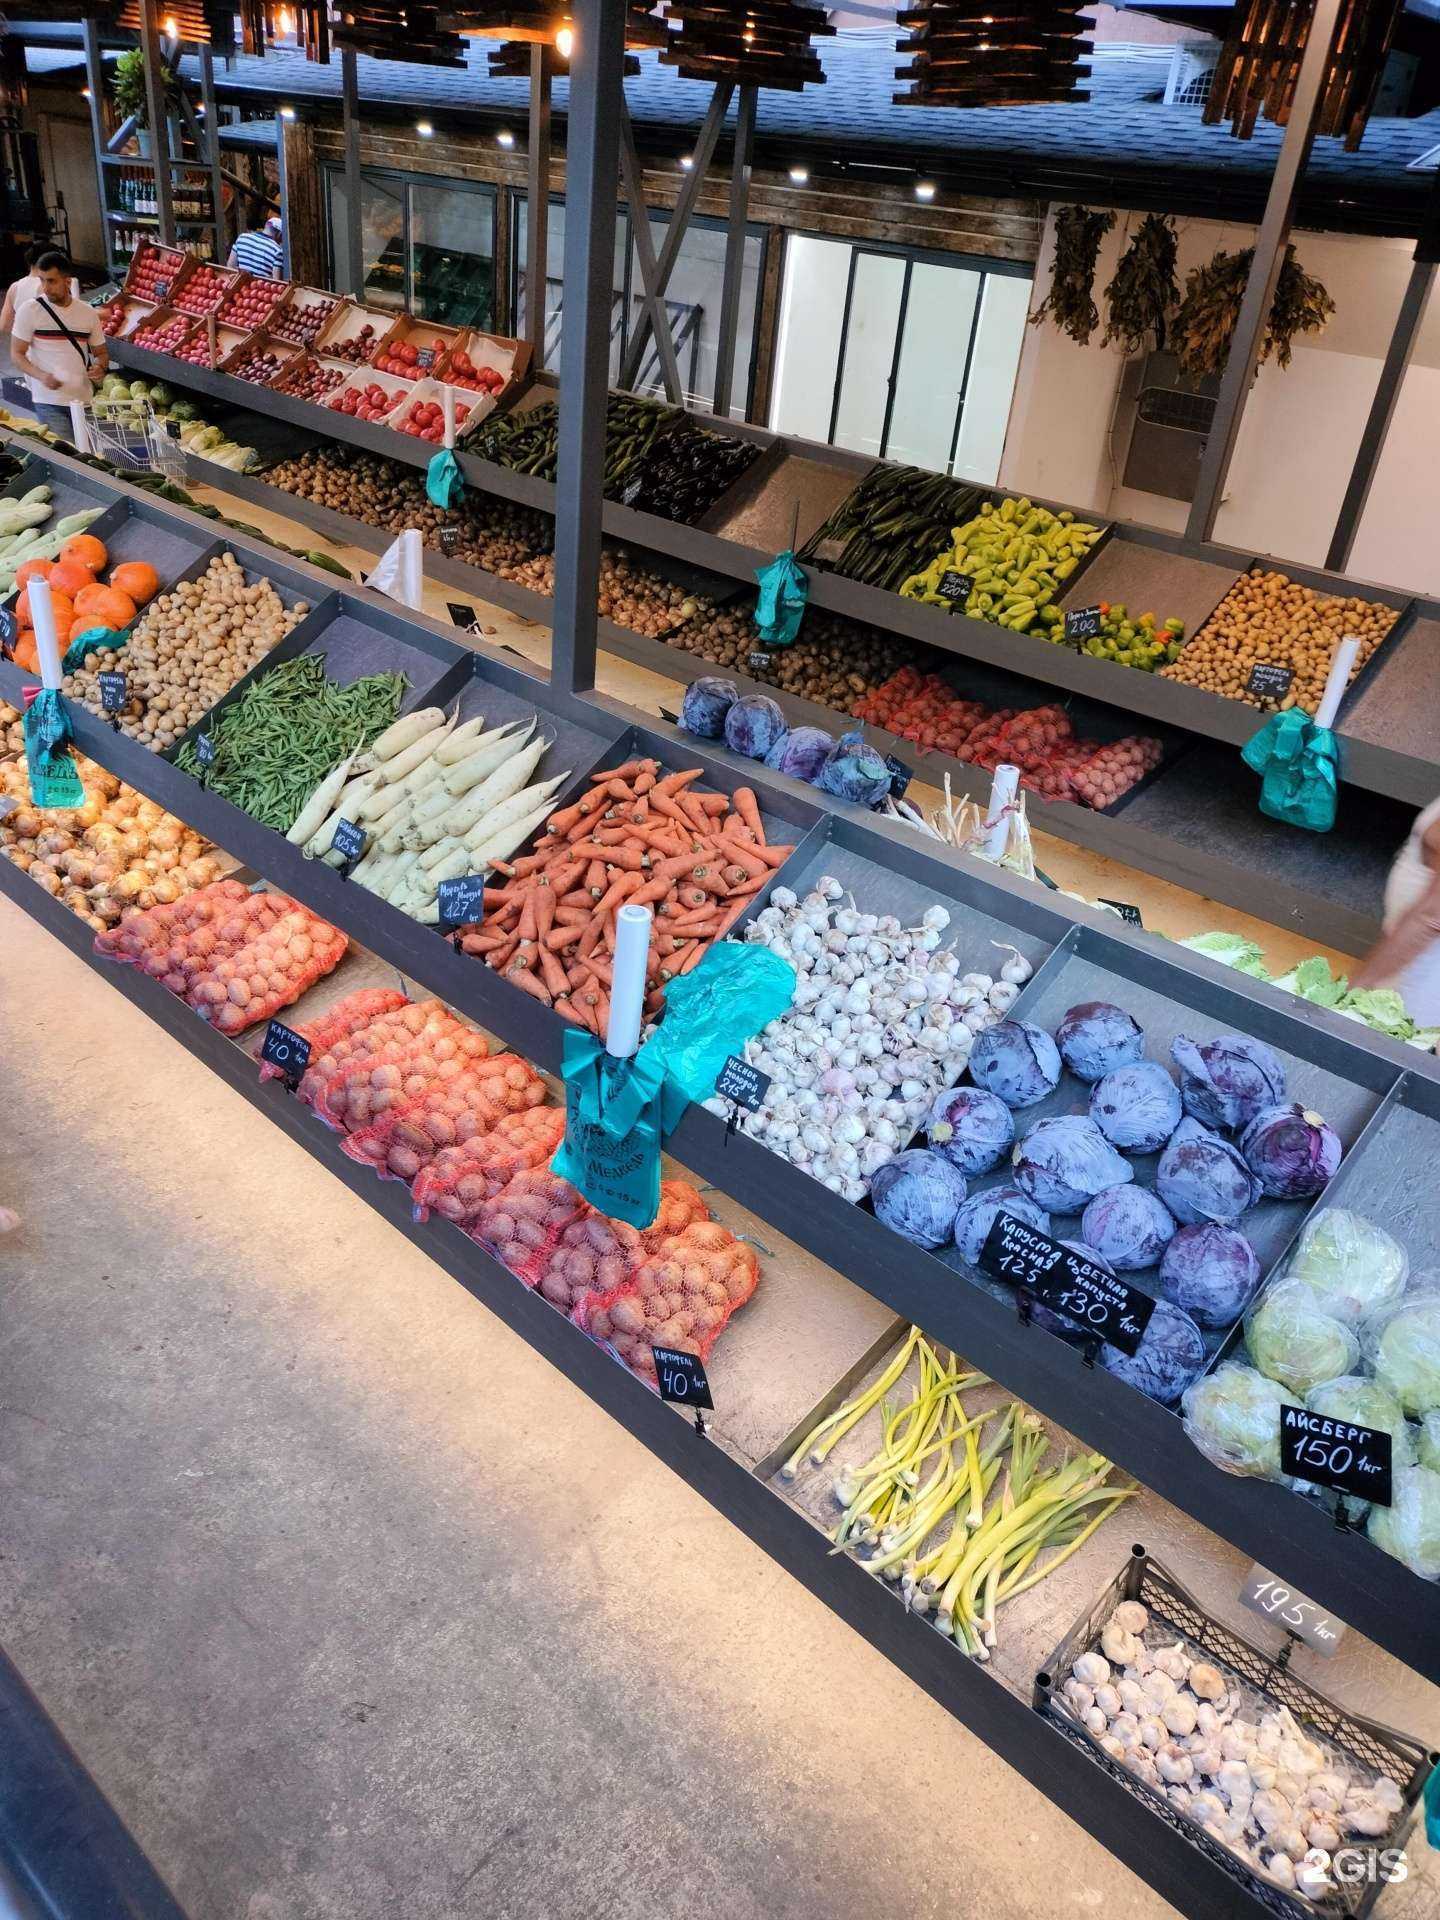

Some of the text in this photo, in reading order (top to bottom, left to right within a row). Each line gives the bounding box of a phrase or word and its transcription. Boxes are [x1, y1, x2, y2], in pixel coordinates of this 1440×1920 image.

[1071, 619, 1096, 634] 200
[268, 1038, 289, 1060] 40
[728, 1058, 758, 1081] ЧЕСНОК
[719, 1078, 742, 1097] 215
[999, 1254, 1043, 1283] 125
[1066, 1256, 1129, 1298] ЦВЕТНАЯ
[1060, 1289, 1109, 1323] 130
[1074, 1275, 1127, 1311] КАПУСТА
[664, 1368, 688, 1395] 40
[1285, 1410, 1373, 1444] АЙСБЕРГ
[1293, 1435, 1353, 1474] 150
[1253, 1581, 1316, 1625] 195
